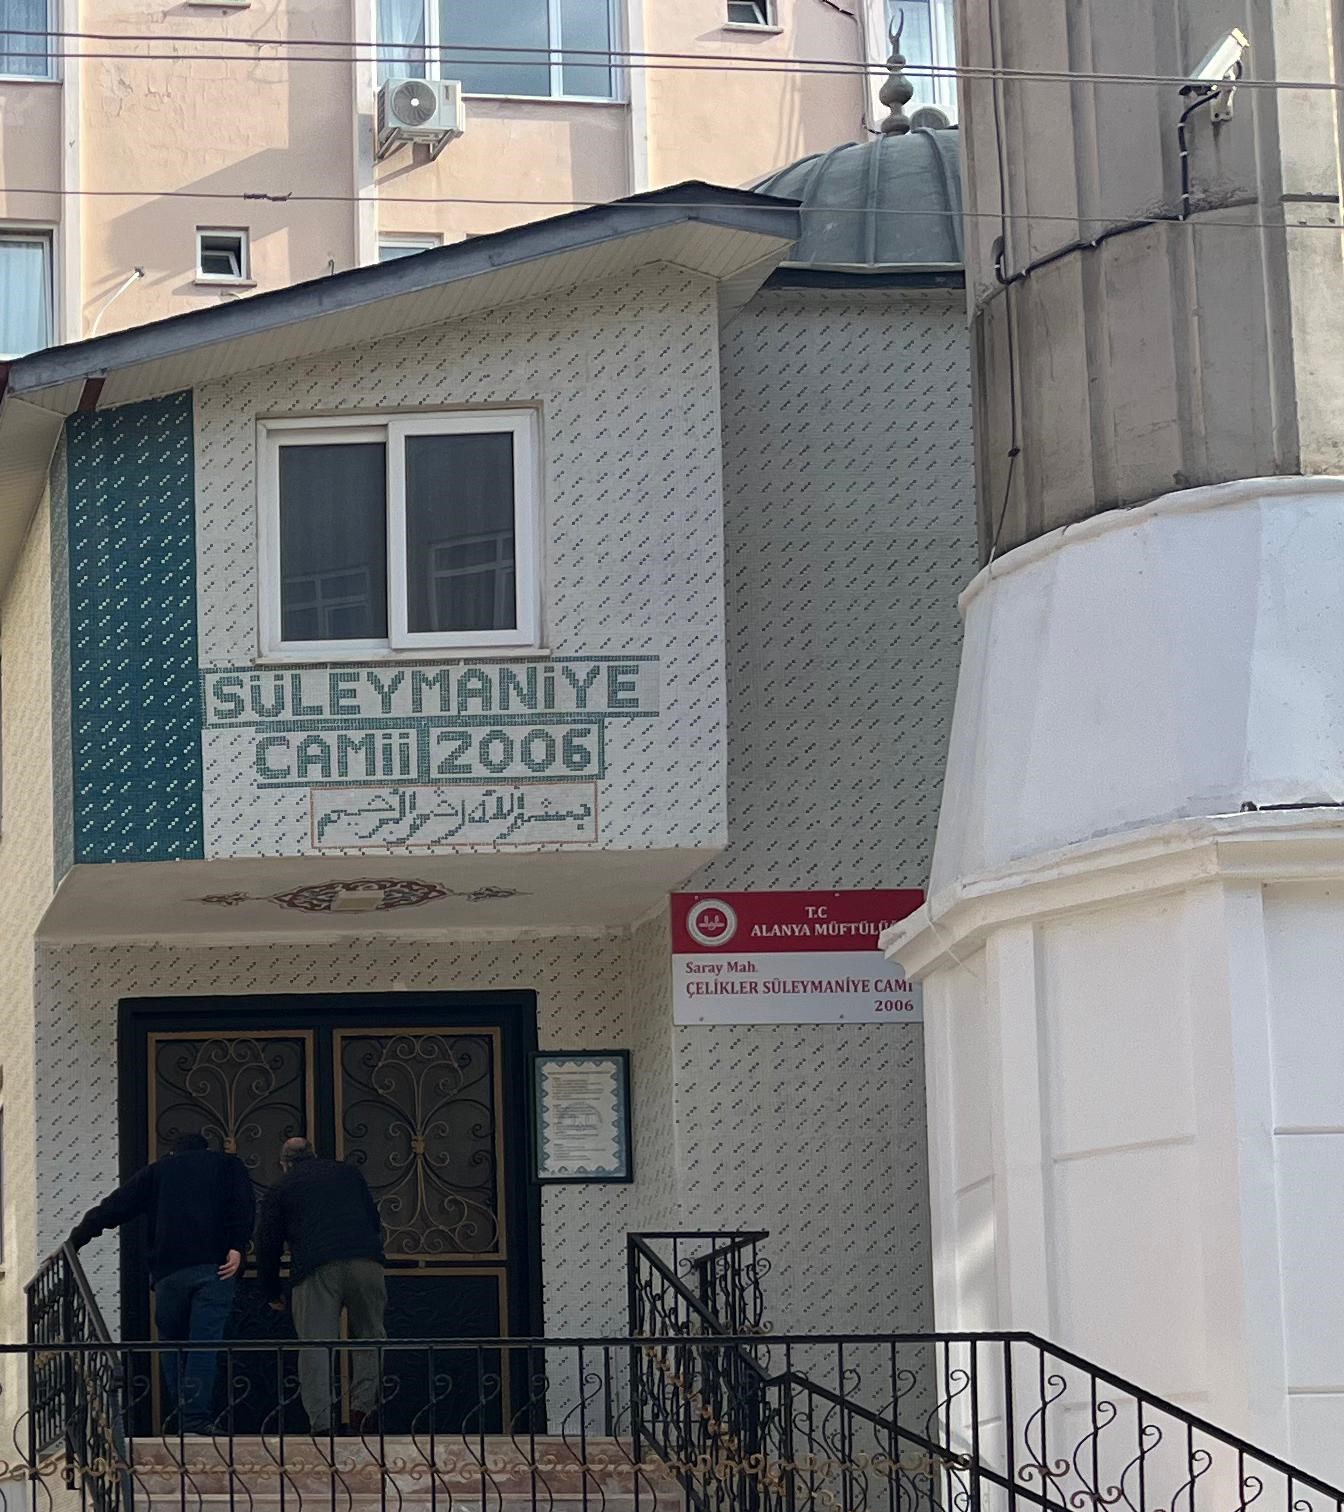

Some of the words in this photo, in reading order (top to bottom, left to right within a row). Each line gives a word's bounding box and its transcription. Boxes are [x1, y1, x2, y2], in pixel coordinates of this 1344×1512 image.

[213, 665, 640, 720] SÜLEYMANİYE
[436, 728, 592, 775] 2006
[751, 924, 811, 937] ALANYA
[686, 961, 723, 976] Saray
[686, 979, 759, 998] ÇELİKLER
[762, 977, 870, 994] SÜLEYMANİYE
[874, 999, 914, 1012] 2006
